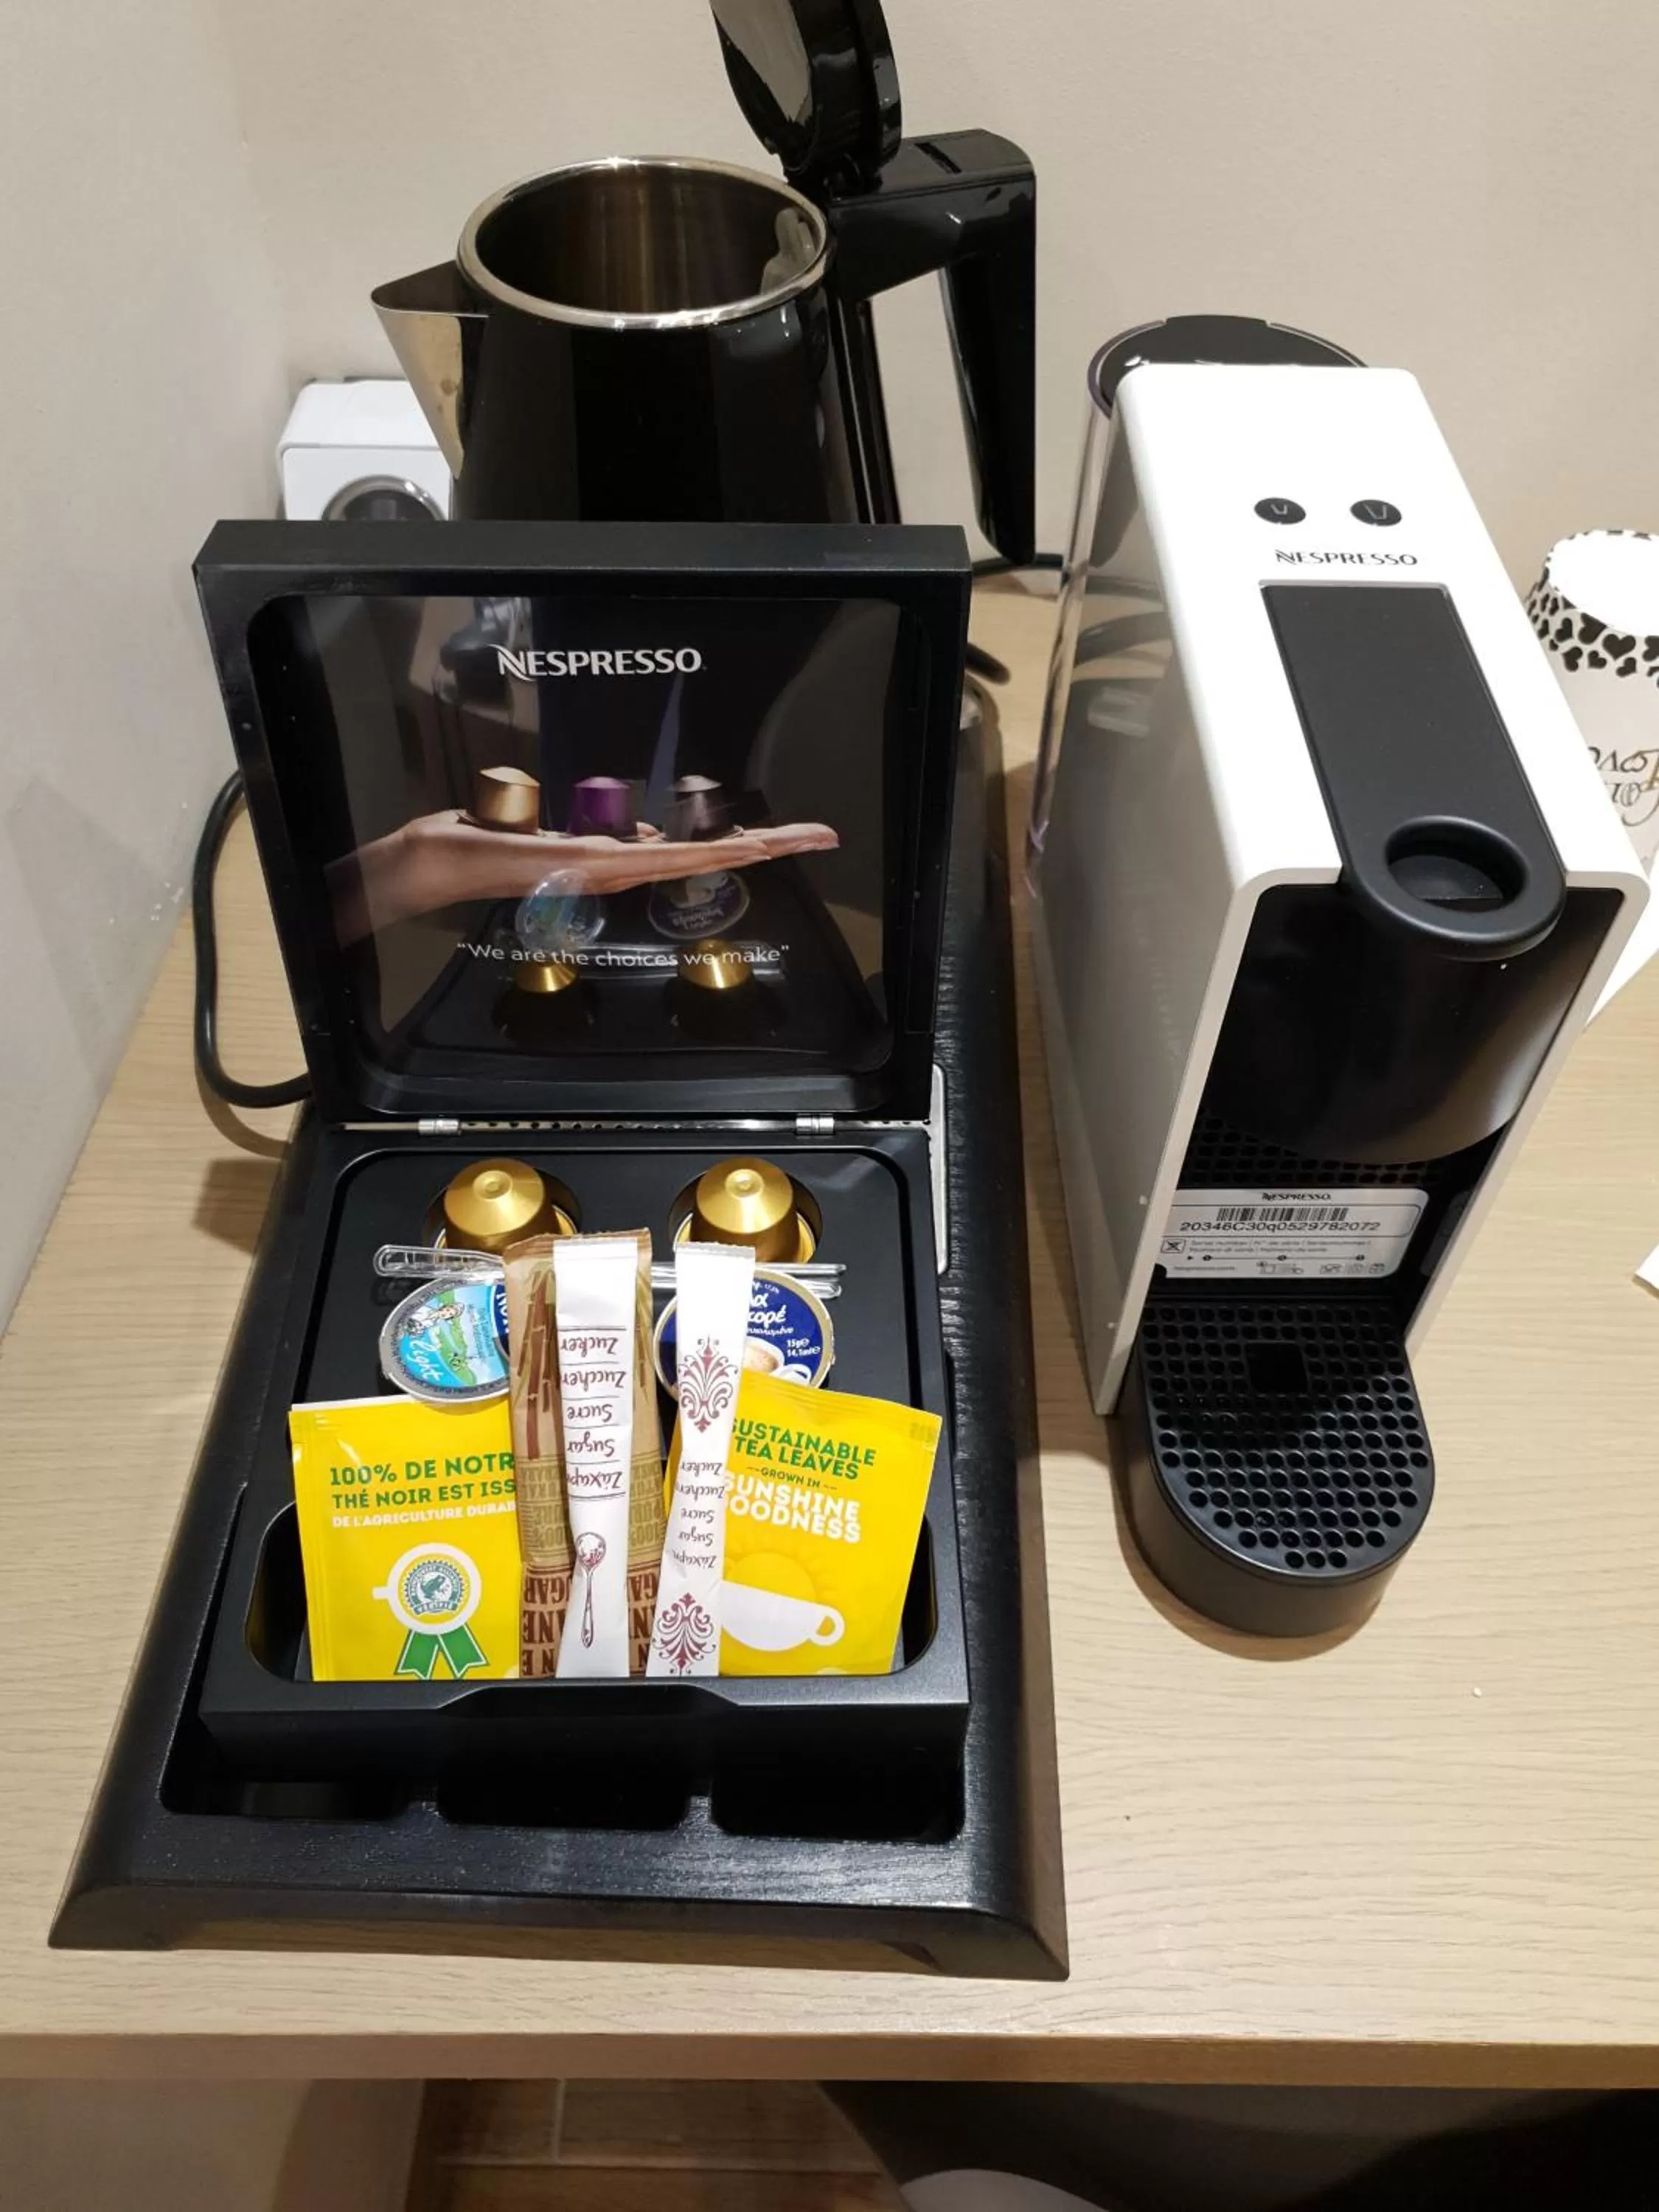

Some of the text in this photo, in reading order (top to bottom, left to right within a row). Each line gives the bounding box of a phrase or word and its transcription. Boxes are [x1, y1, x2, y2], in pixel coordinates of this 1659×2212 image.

[1275, 549, 1417, 566] NESPRESSO
[490, 644, 702, 681] NESPRESSO
[511, 950, 546, 963] are
[551, 950, 589, 966] the
[595, 950, 678, 967] choices
[684, 953, 716, 965] we
[1262, 1192, 1332, 1202] NESPRESSO
[560, 1337, 618, 1357] Zucker
[562, 1371, 627, 1392] Zuccher
[567, 1404, 613, 1422] Sucre
[566, 1431, 616, 1458] Sugar
[330, 1463, 397, 1486] 100%
[405, 1458, 437, 1481] DE
[445, 1451, 515, 1477] NOTR
[735, 1436, 858, 1480] TEA LEAVES
[566, 1467, 623, 1491] Ζάχαρ
[680, 1461, 723, 1477] Zucker
[761, 1467, 821, 1488] GROWN IN
[332, 1478, 517, 1509] THÉ NOIR EST ISS
[677, 1484, 725, 1503] Zuccher
[333, 1517, 351, 1528] DE
[467, 1501, 516, 1517] DURAB
[681, 1507, 715, 1524] Sucre
[726, 1495, 861, 1543] OODNESS
[678, 1526, 714, 1547] Sugar
